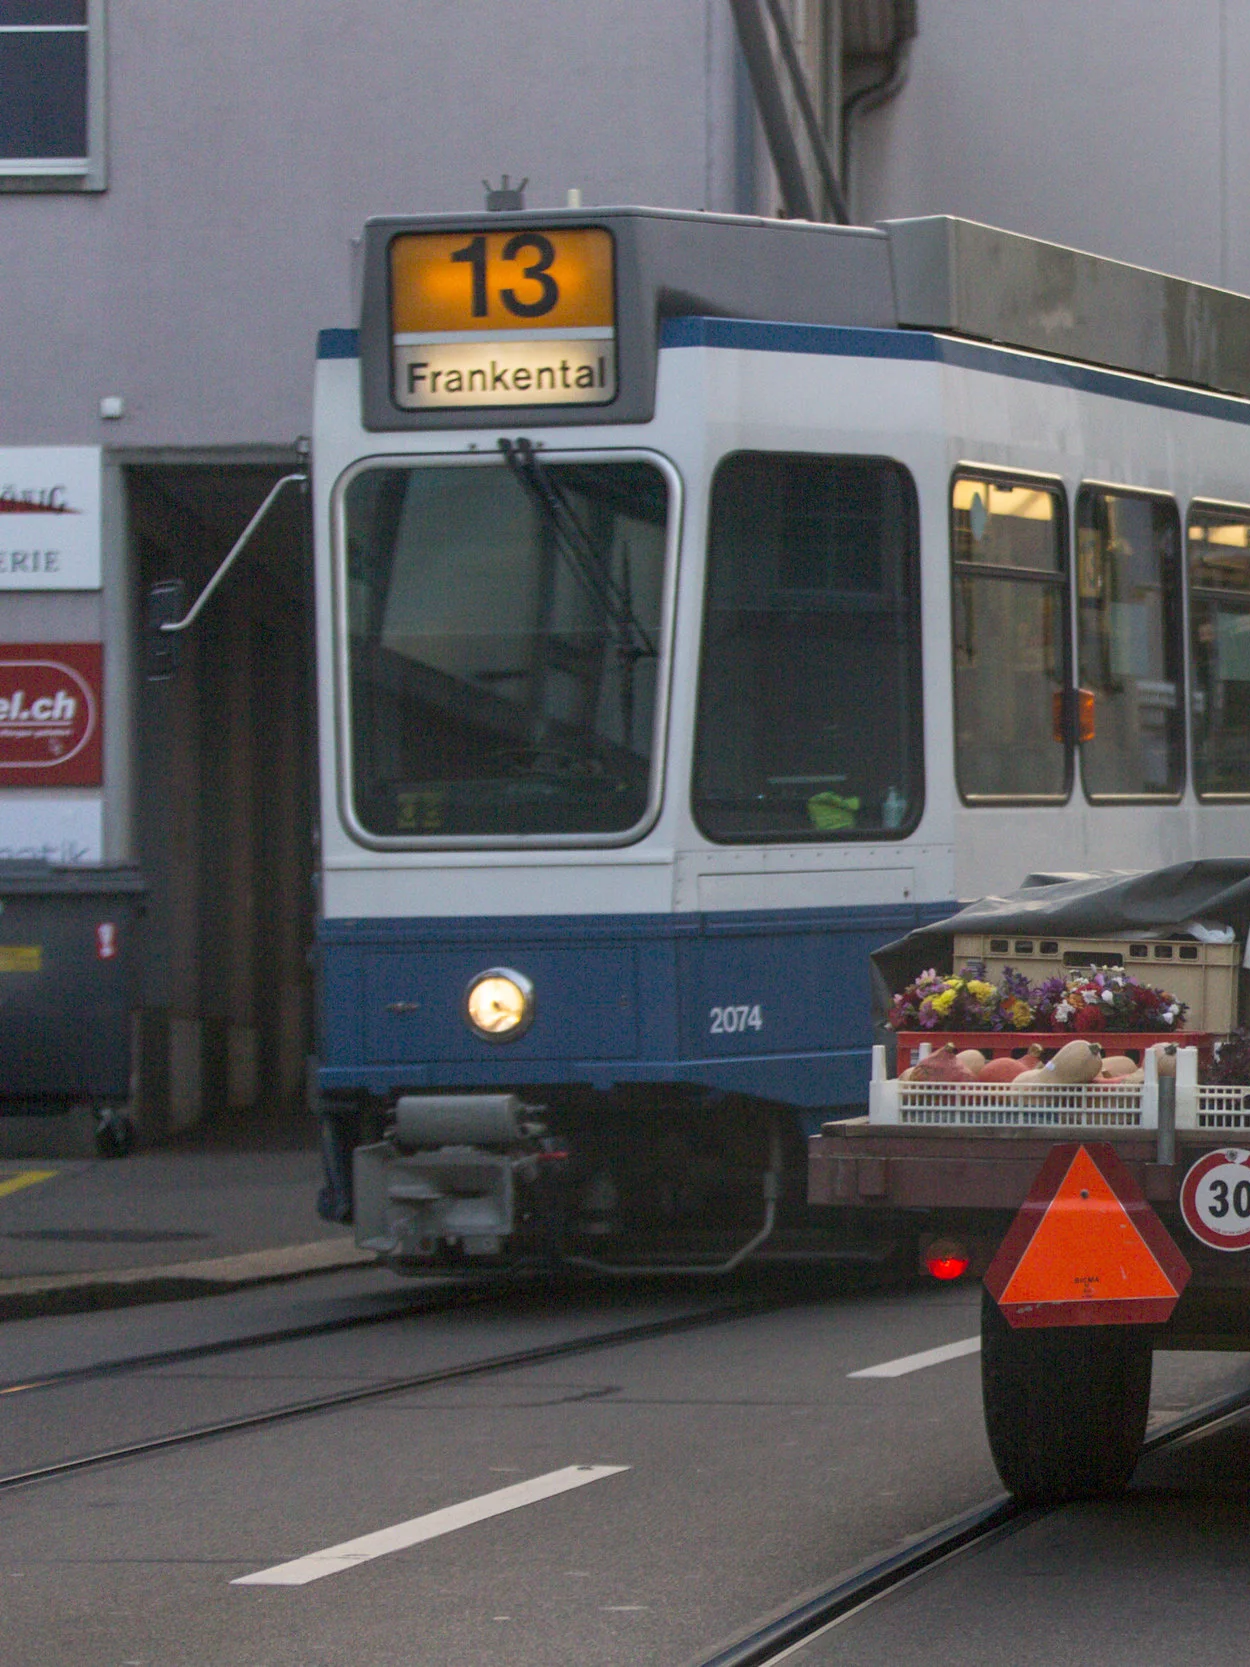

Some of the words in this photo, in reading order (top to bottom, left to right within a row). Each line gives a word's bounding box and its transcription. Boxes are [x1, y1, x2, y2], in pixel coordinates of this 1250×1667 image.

[449, 232, 560, 319] 13
[407, 355, 607, 396] Frankental
[709, 1004, 763, 1034] 2074
